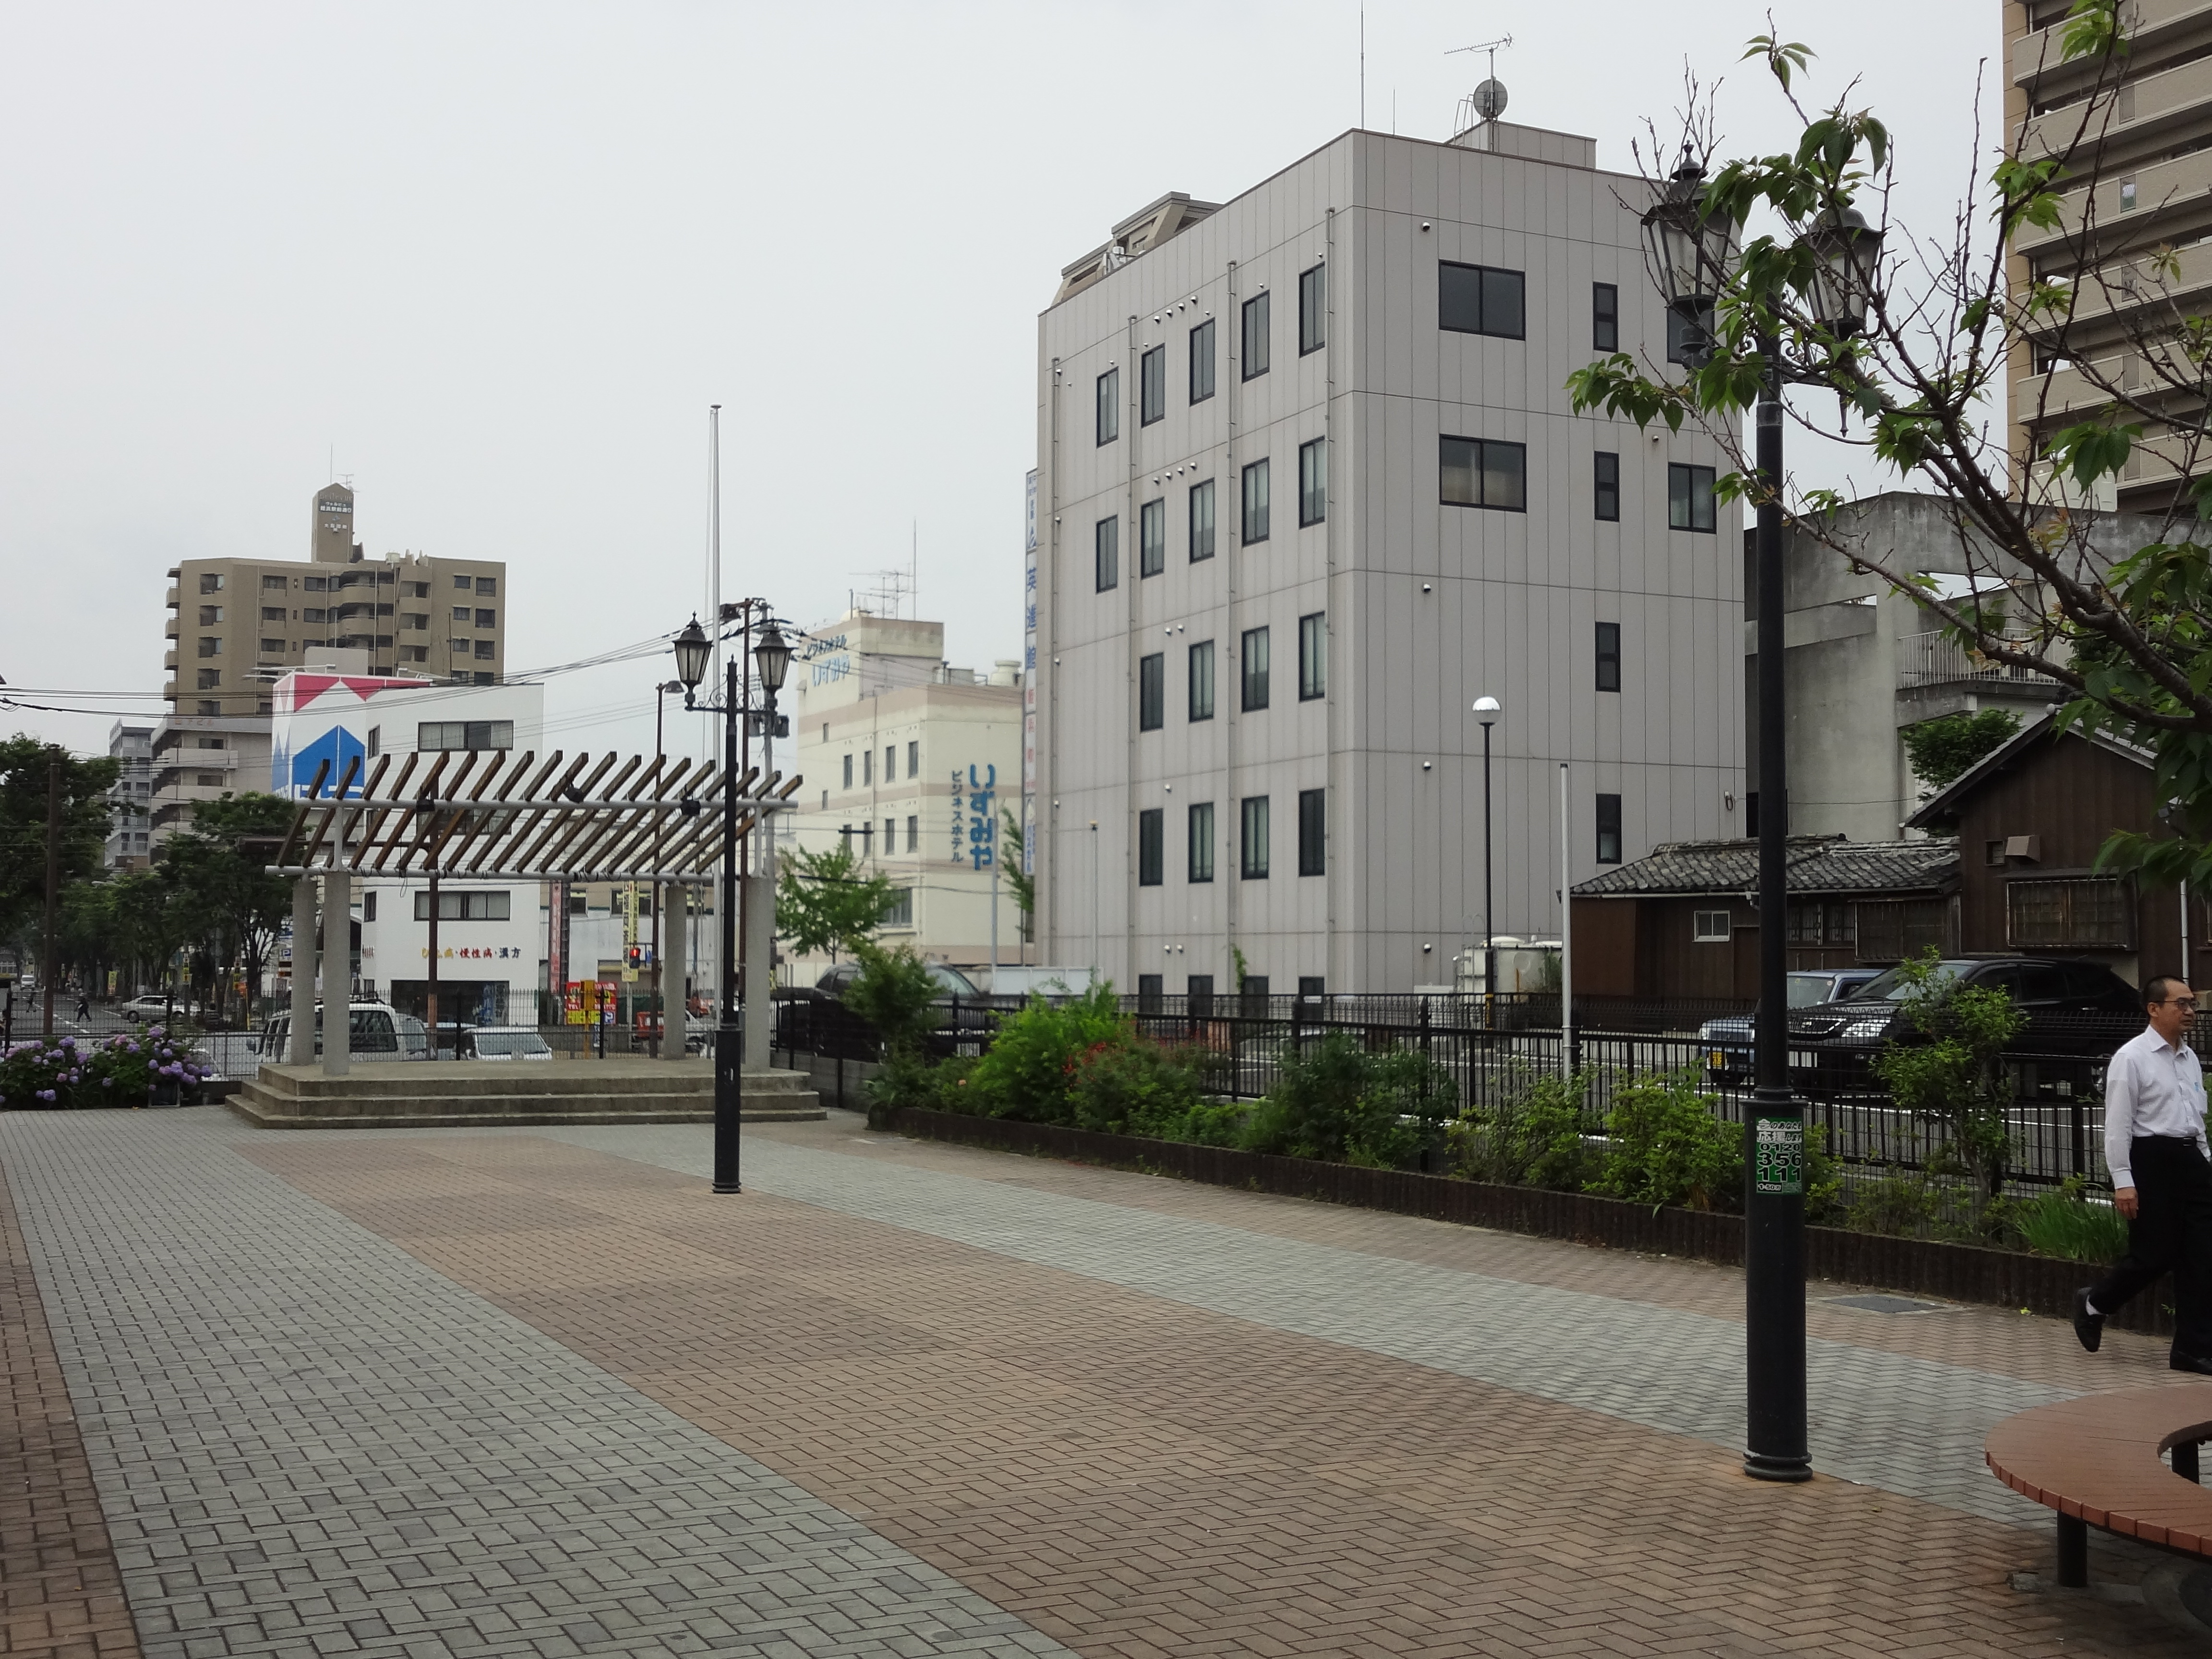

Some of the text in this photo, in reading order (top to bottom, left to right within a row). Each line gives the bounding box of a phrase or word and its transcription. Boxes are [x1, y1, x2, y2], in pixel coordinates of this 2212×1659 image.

[951, 769, 963, 862] ビジネスホテル
[969, 763, 996, 870] いずみや
[1759, 1143, 1801, 1152] 0120
[1757, 1153, 1801, 1166] 356
[1757, 1167, 1801, 1181] 111
